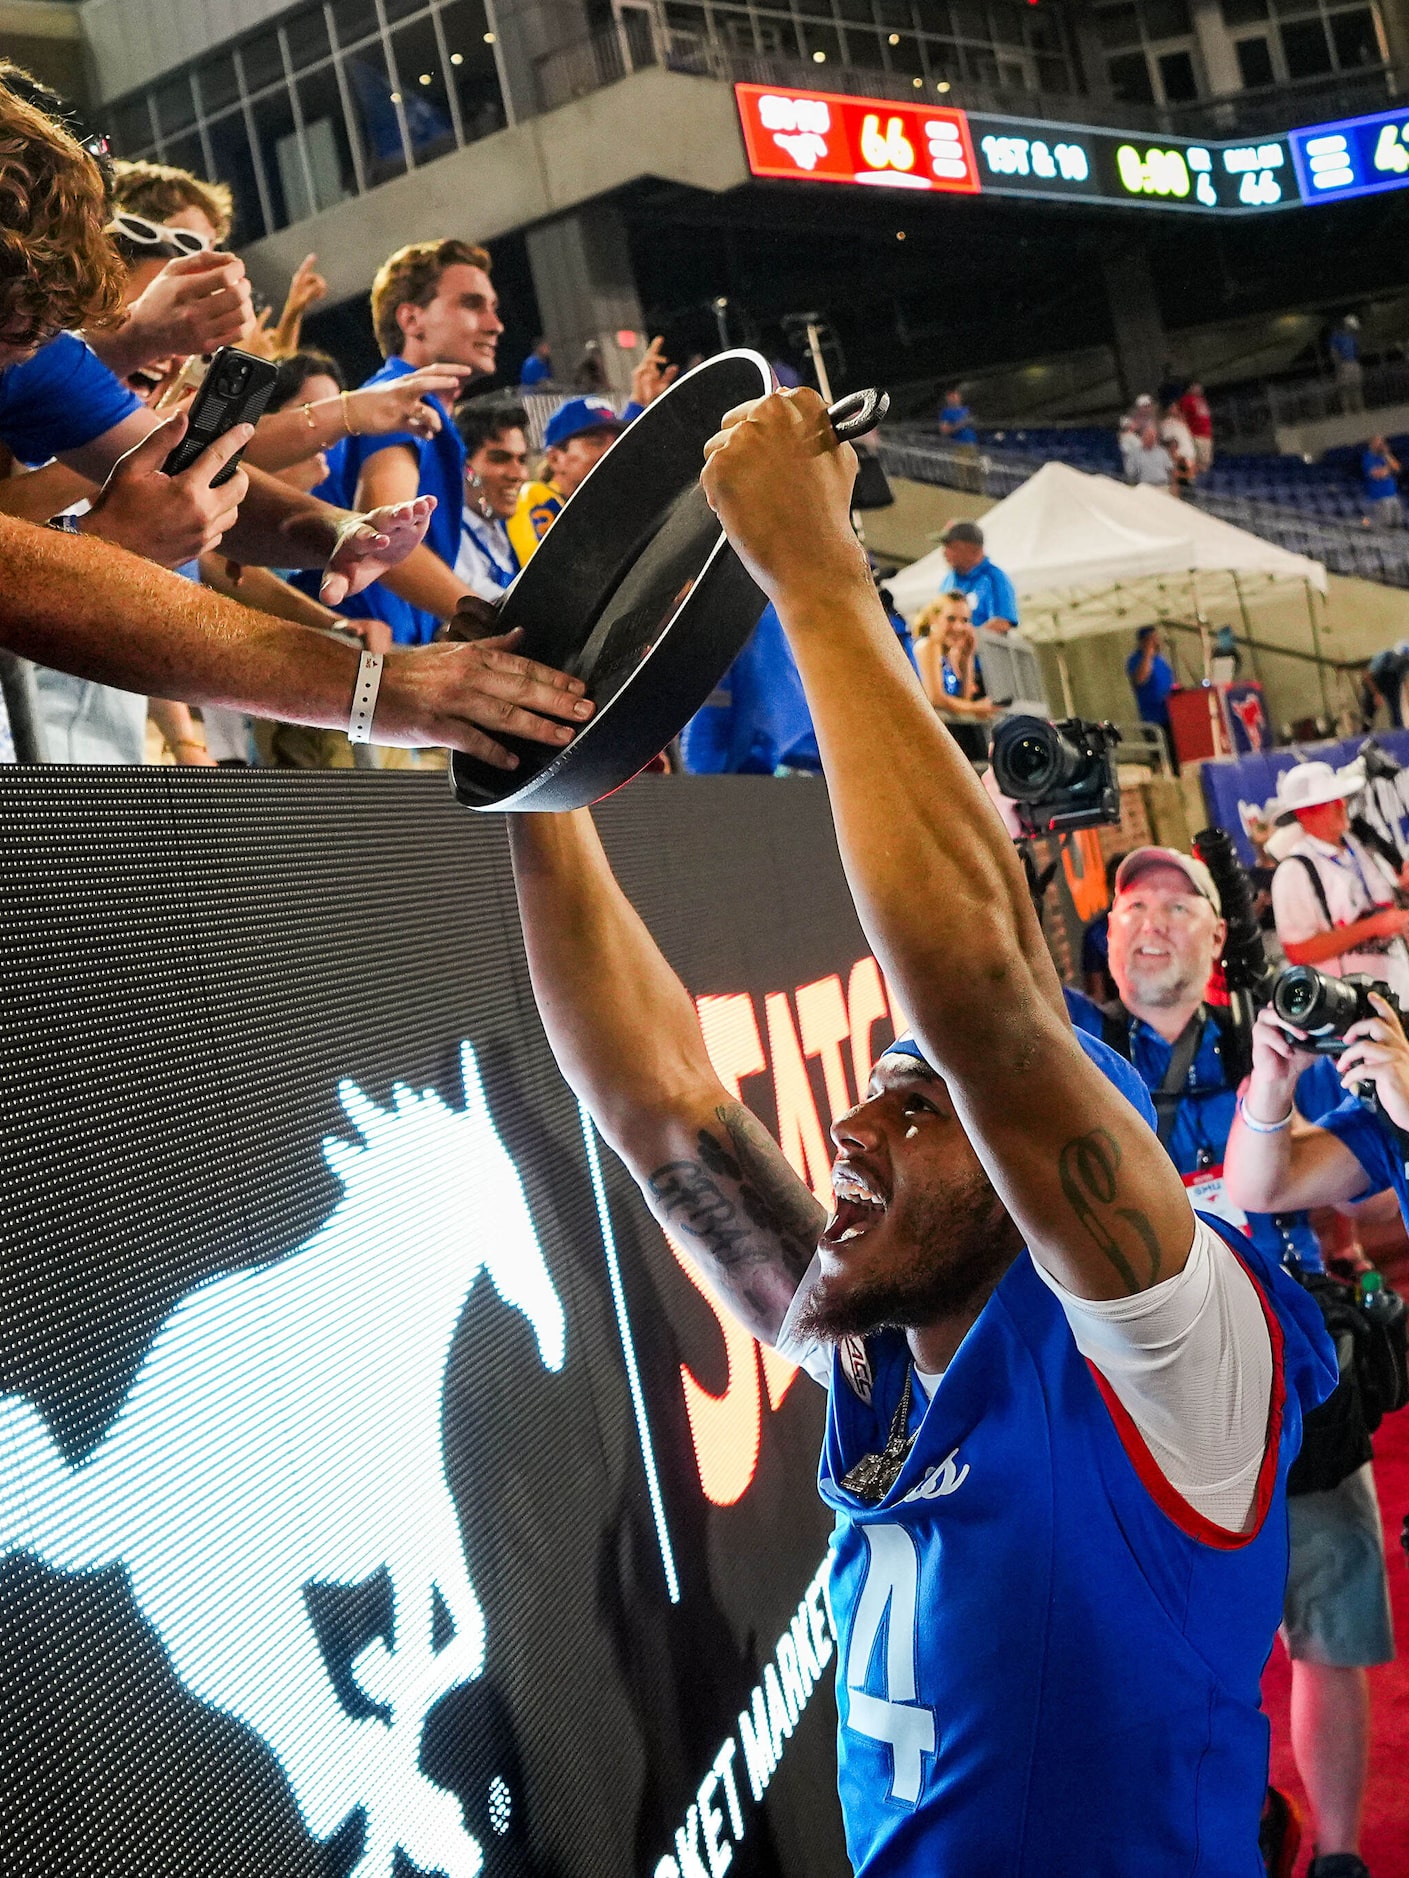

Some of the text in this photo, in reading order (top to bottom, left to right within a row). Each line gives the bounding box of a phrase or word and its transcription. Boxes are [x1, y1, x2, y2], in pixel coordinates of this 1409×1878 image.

[860, 113, 915, 171] 66
[981, 135, 1030, 175] 1ST
[846, 1523, 937, 1804] 4
[654, 1736, 745, 1878] KET
